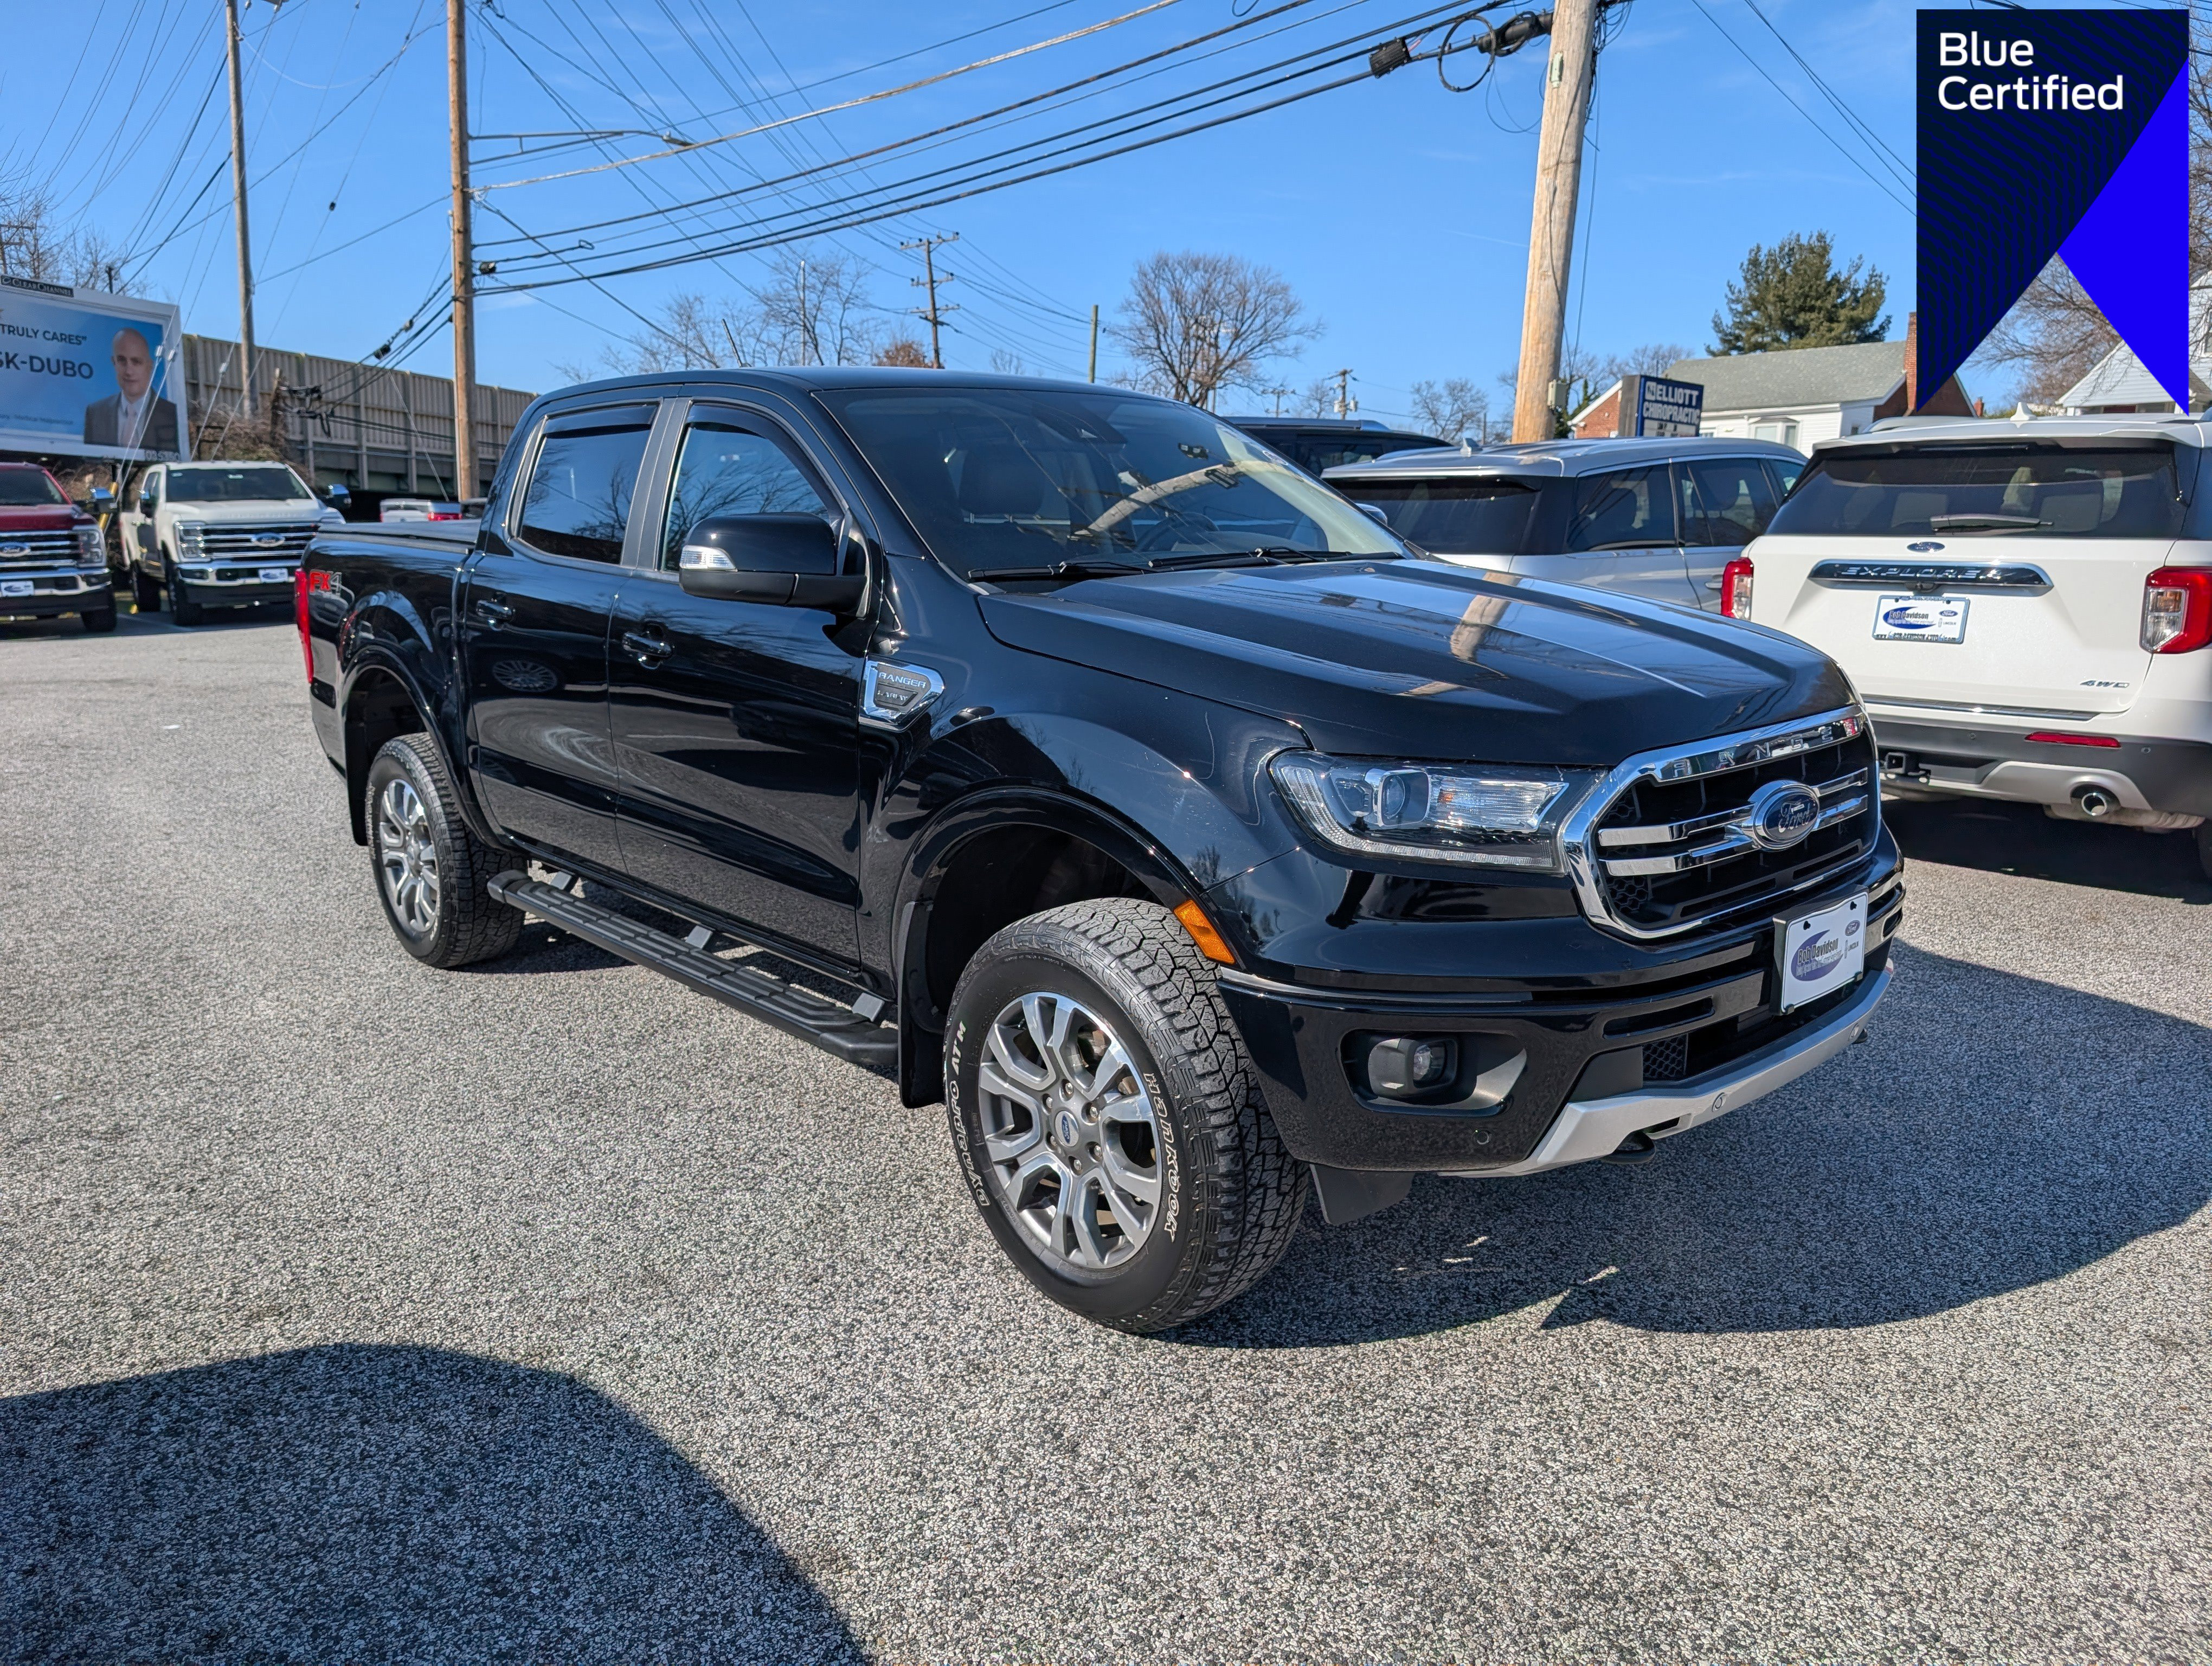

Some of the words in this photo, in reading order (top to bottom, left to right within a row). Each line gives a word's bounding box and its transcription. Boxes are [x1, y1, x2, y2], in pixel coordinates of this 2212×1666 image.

[0, 324, 40, 339] TRULY
[1656, 384, 1700, 407] ELLIOTT
[1643, 401, 1701, 425] CHIROPRACTIC
[310, 569, 343, 598] FX4
[1902, 611, 1929, 620] Davidson
[878, 672, 926, 689] RANGER
[1778, 800, 1811, 834] Ford
[1798, 946, 1811, 964] Bob
[1811, 938, 1839, 959] Davidson
